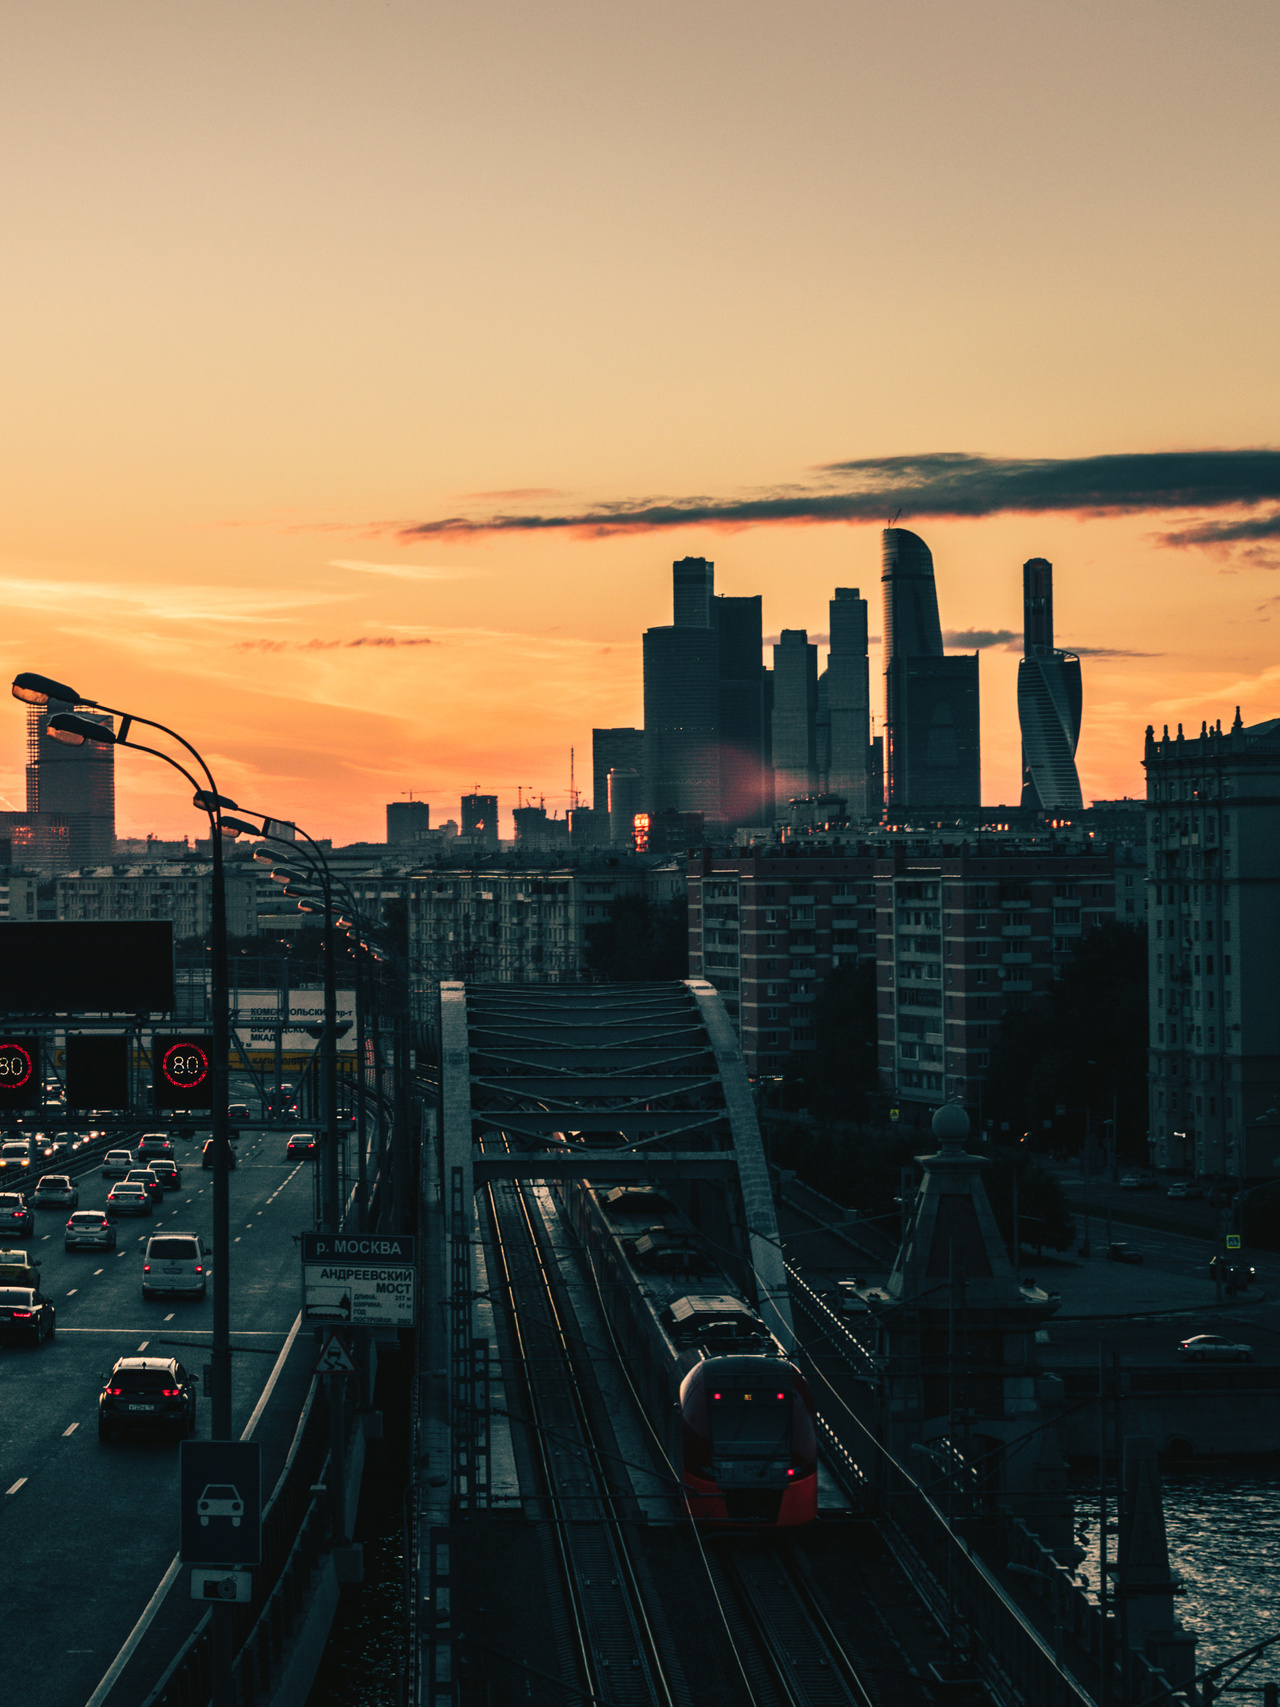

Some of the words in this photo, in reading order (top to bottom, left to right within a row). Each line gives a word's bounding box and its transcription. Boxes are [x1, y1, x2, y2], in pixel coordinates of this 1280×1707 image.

[173, 1055, 199, 1075] 80
[316, 1242, 330, 1255] р.
[334, 1240, 402, 1255] МОСКВА
[320, 1268, 412, 1282] АНДРЕЕВСКИЙ
[376, 1283, 412, 1294] МОСТ
